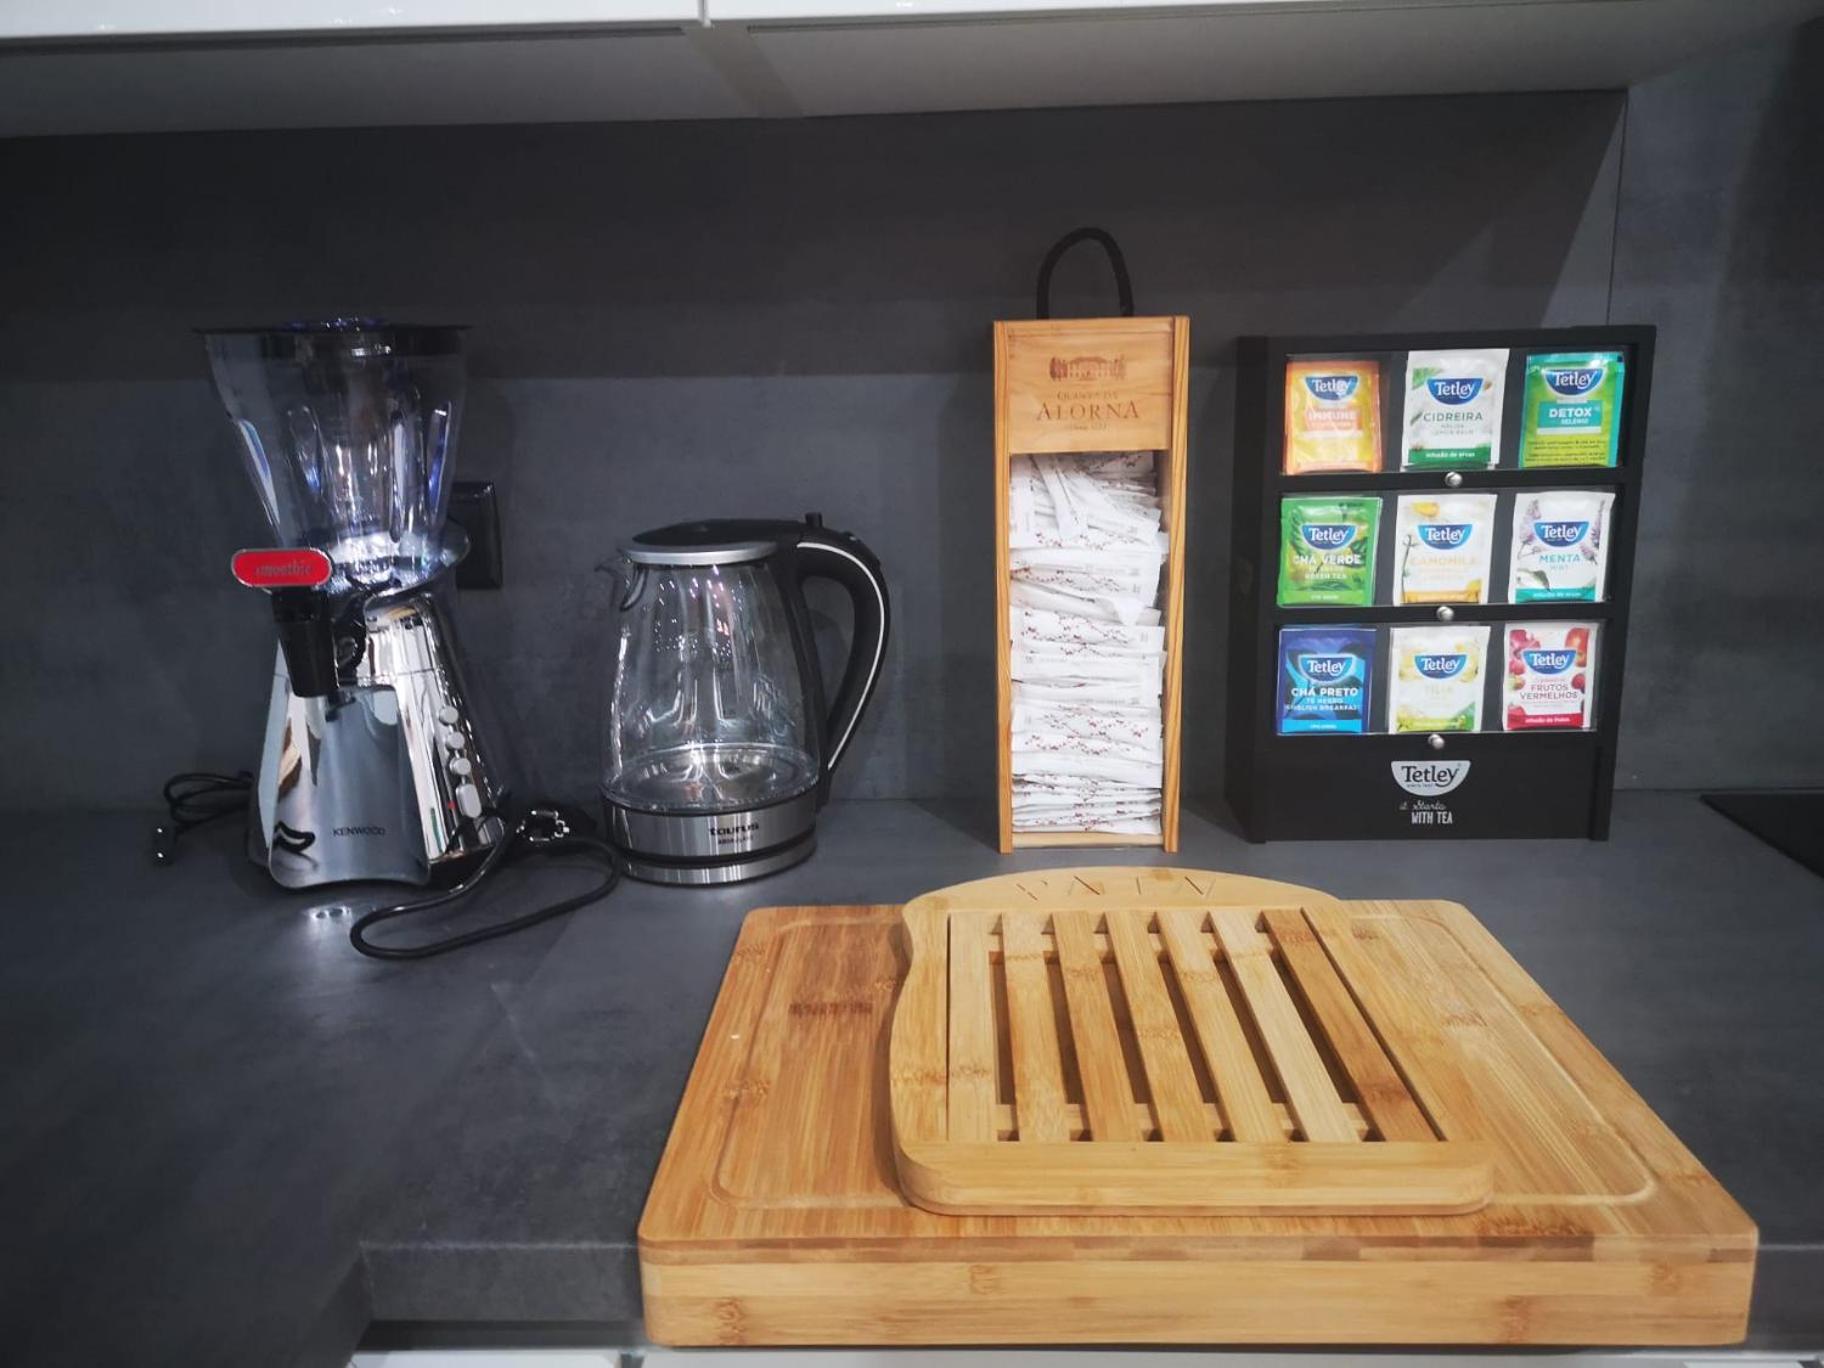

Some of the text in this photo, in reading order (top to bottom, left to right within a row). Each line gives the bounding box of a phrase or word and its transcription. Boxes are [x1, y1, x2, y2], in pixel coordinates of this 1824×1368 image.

[1312, 378, 1352, 396] Tetley
[1552, 370, 1598, 390] Tetley
[1434, 380, 1476, 400] Tetley
[1036, 400, 1139, 420] ALORNA
[1423, 411, 1484, 423] CIDREIRA
[1548, 407, 1593, 419] DETOX
[1309, 527, 1349, 545] Tetley
[1425, 528, 1465, 545] Tetley
[1541, 525, 1583, 542] Tetley
[1321, 554, 1362, 565] VERDE
[1538, 553, 1581, 564] MENTA
[1306, 659, 1346, 677] Tetley
[1420, 657, 1460, 674] Tetley
[1529, 653, 1570, 670] Tetley
[1320, 687, 1359, 697] PRETO
[1519, 691, 1578, 700] VERMELHOS
[1530, 684, 1569, 692] FRUTOS
[1400, 764, 1461, 788] Tetley
[1411, 811, 1454, 825] WITH TEA
[333, 825, 386, 836] KENWOOD
[709, 823, 760, 836] taurus
